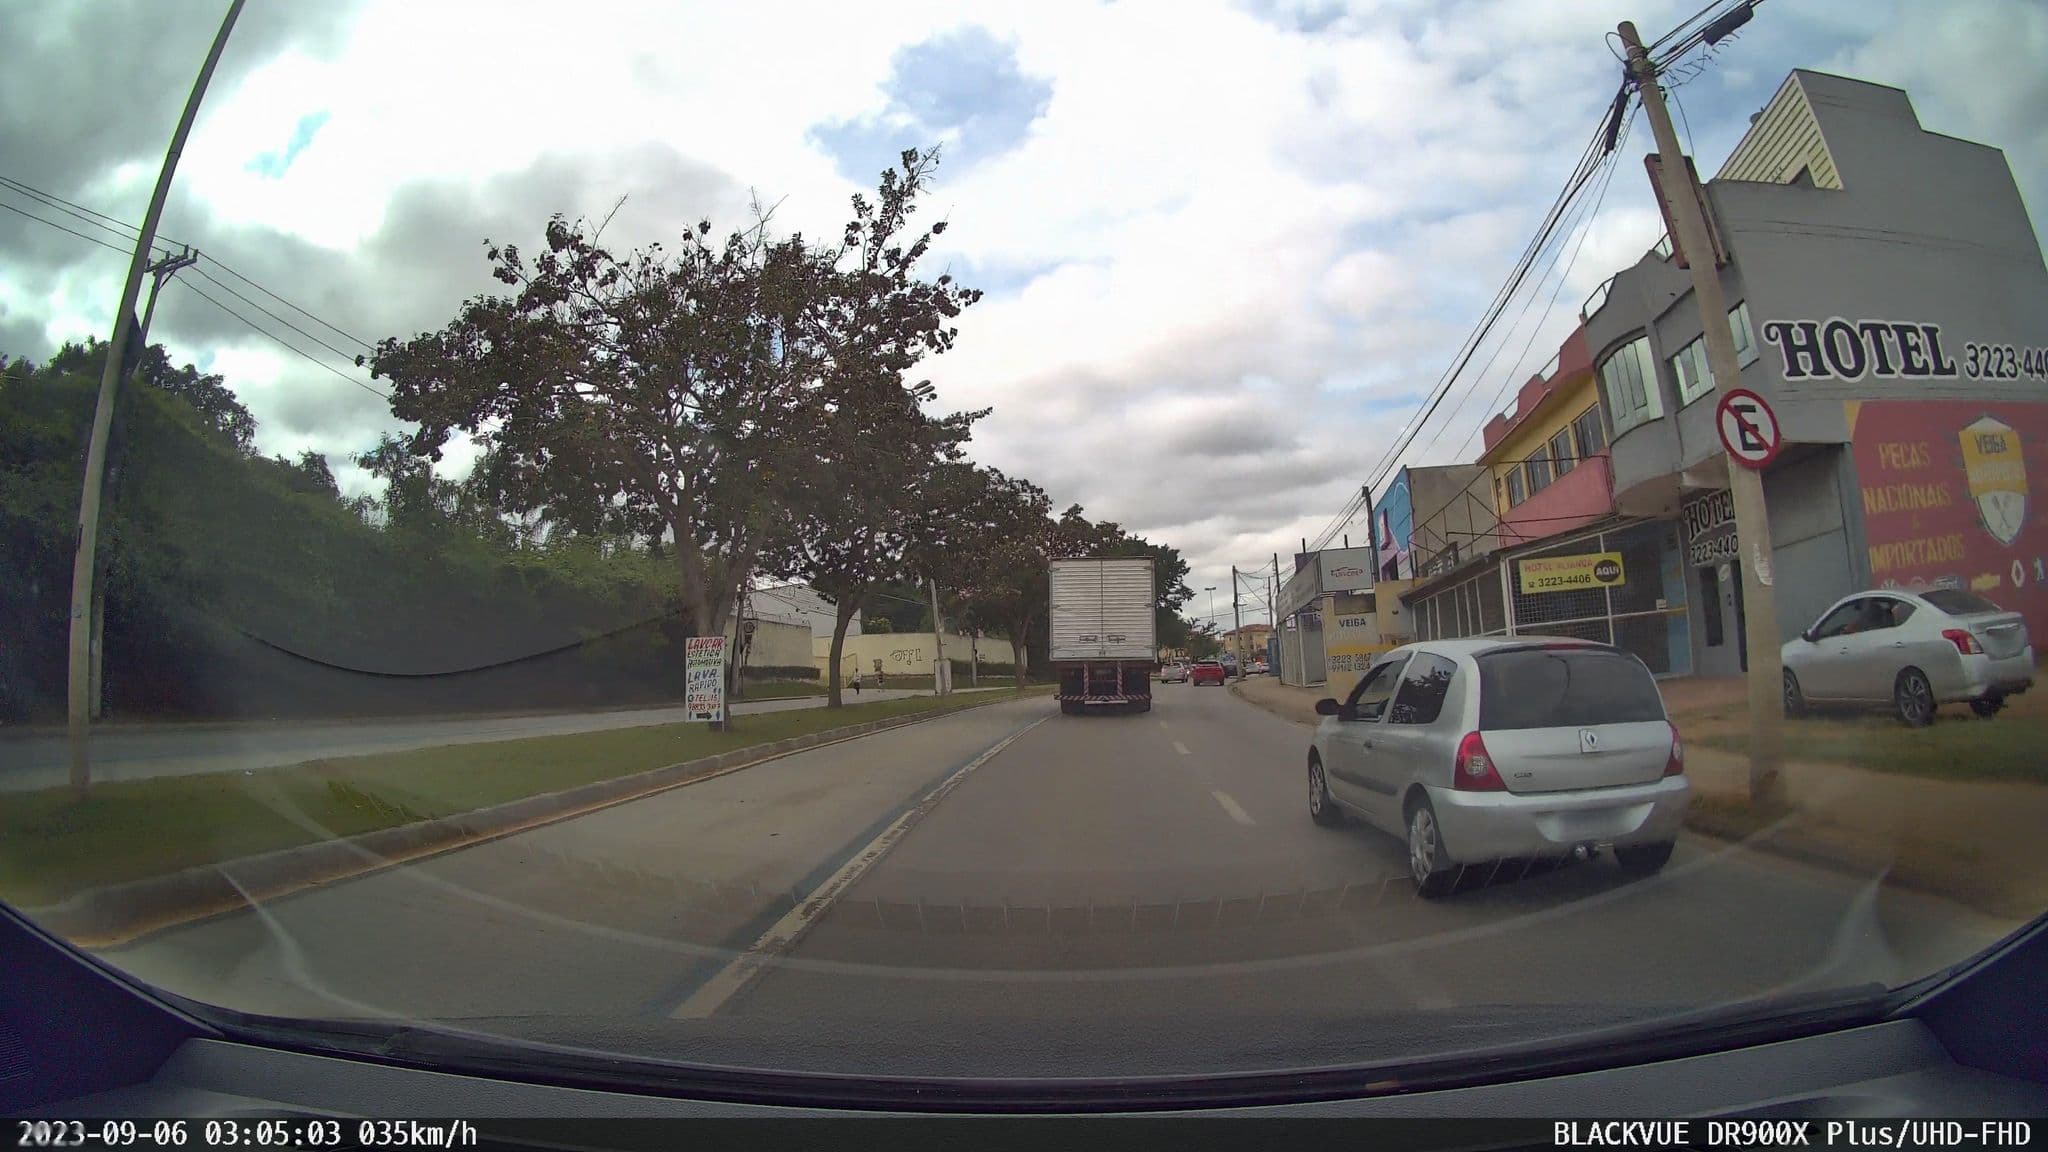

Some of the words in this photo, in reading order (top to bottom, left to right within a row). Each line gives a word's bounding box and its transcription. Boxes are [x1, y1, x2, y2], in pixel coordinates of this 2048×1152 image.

[1765, 318, 1957, 380] HOTEL
[1734, 404, 1764, 451] E
[1596, 565, 1621, 576] AQUI
[1538, 574, 1591, 588] 3223-4406
[1339, 618, 1366, 628] VEIGA
